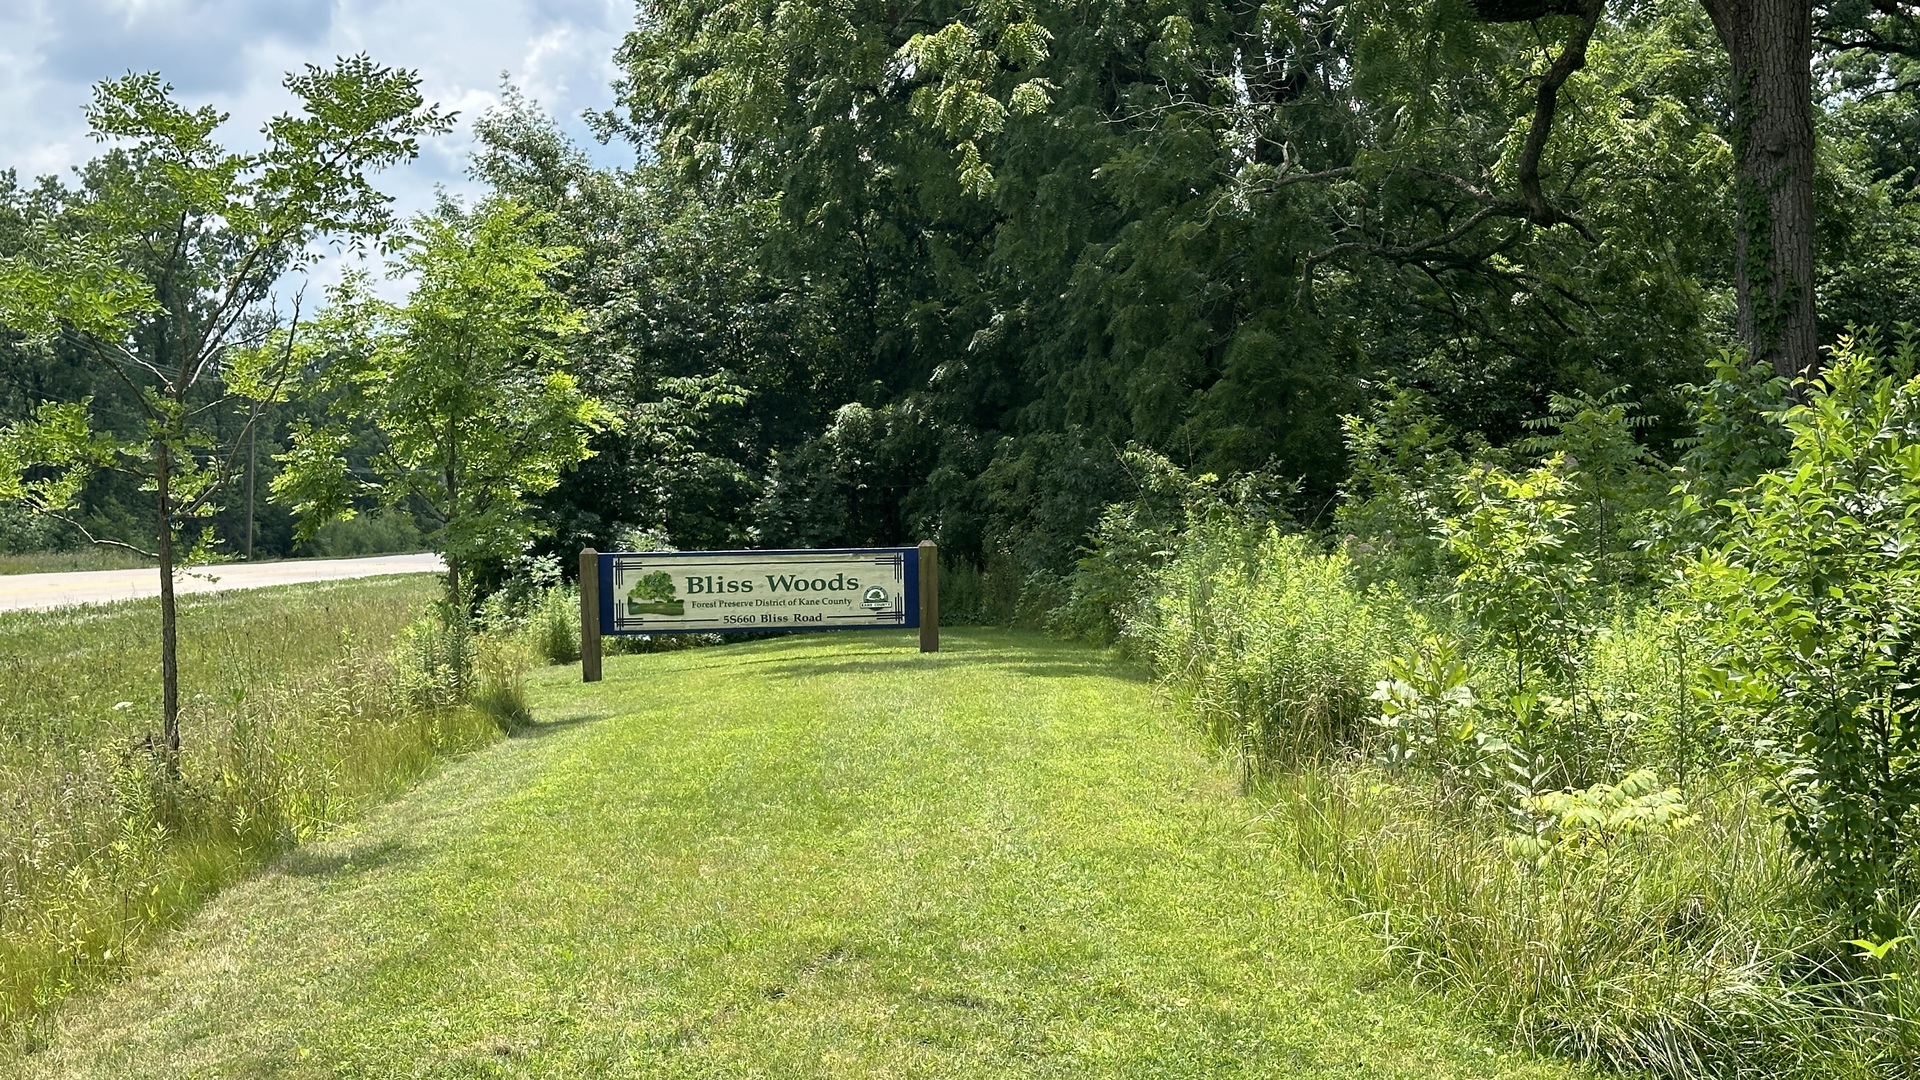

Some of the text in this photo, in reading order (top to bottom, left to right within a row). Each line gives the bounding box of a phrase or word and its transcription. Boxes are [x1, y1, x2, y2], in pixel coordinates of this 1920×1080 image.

[685, 572, 860, 594] Bliss Woods
[691, 597, 852, 608] Forest Preserve District of Kane County
[723, 612, 822, 624] 5S660 Bliss Road
